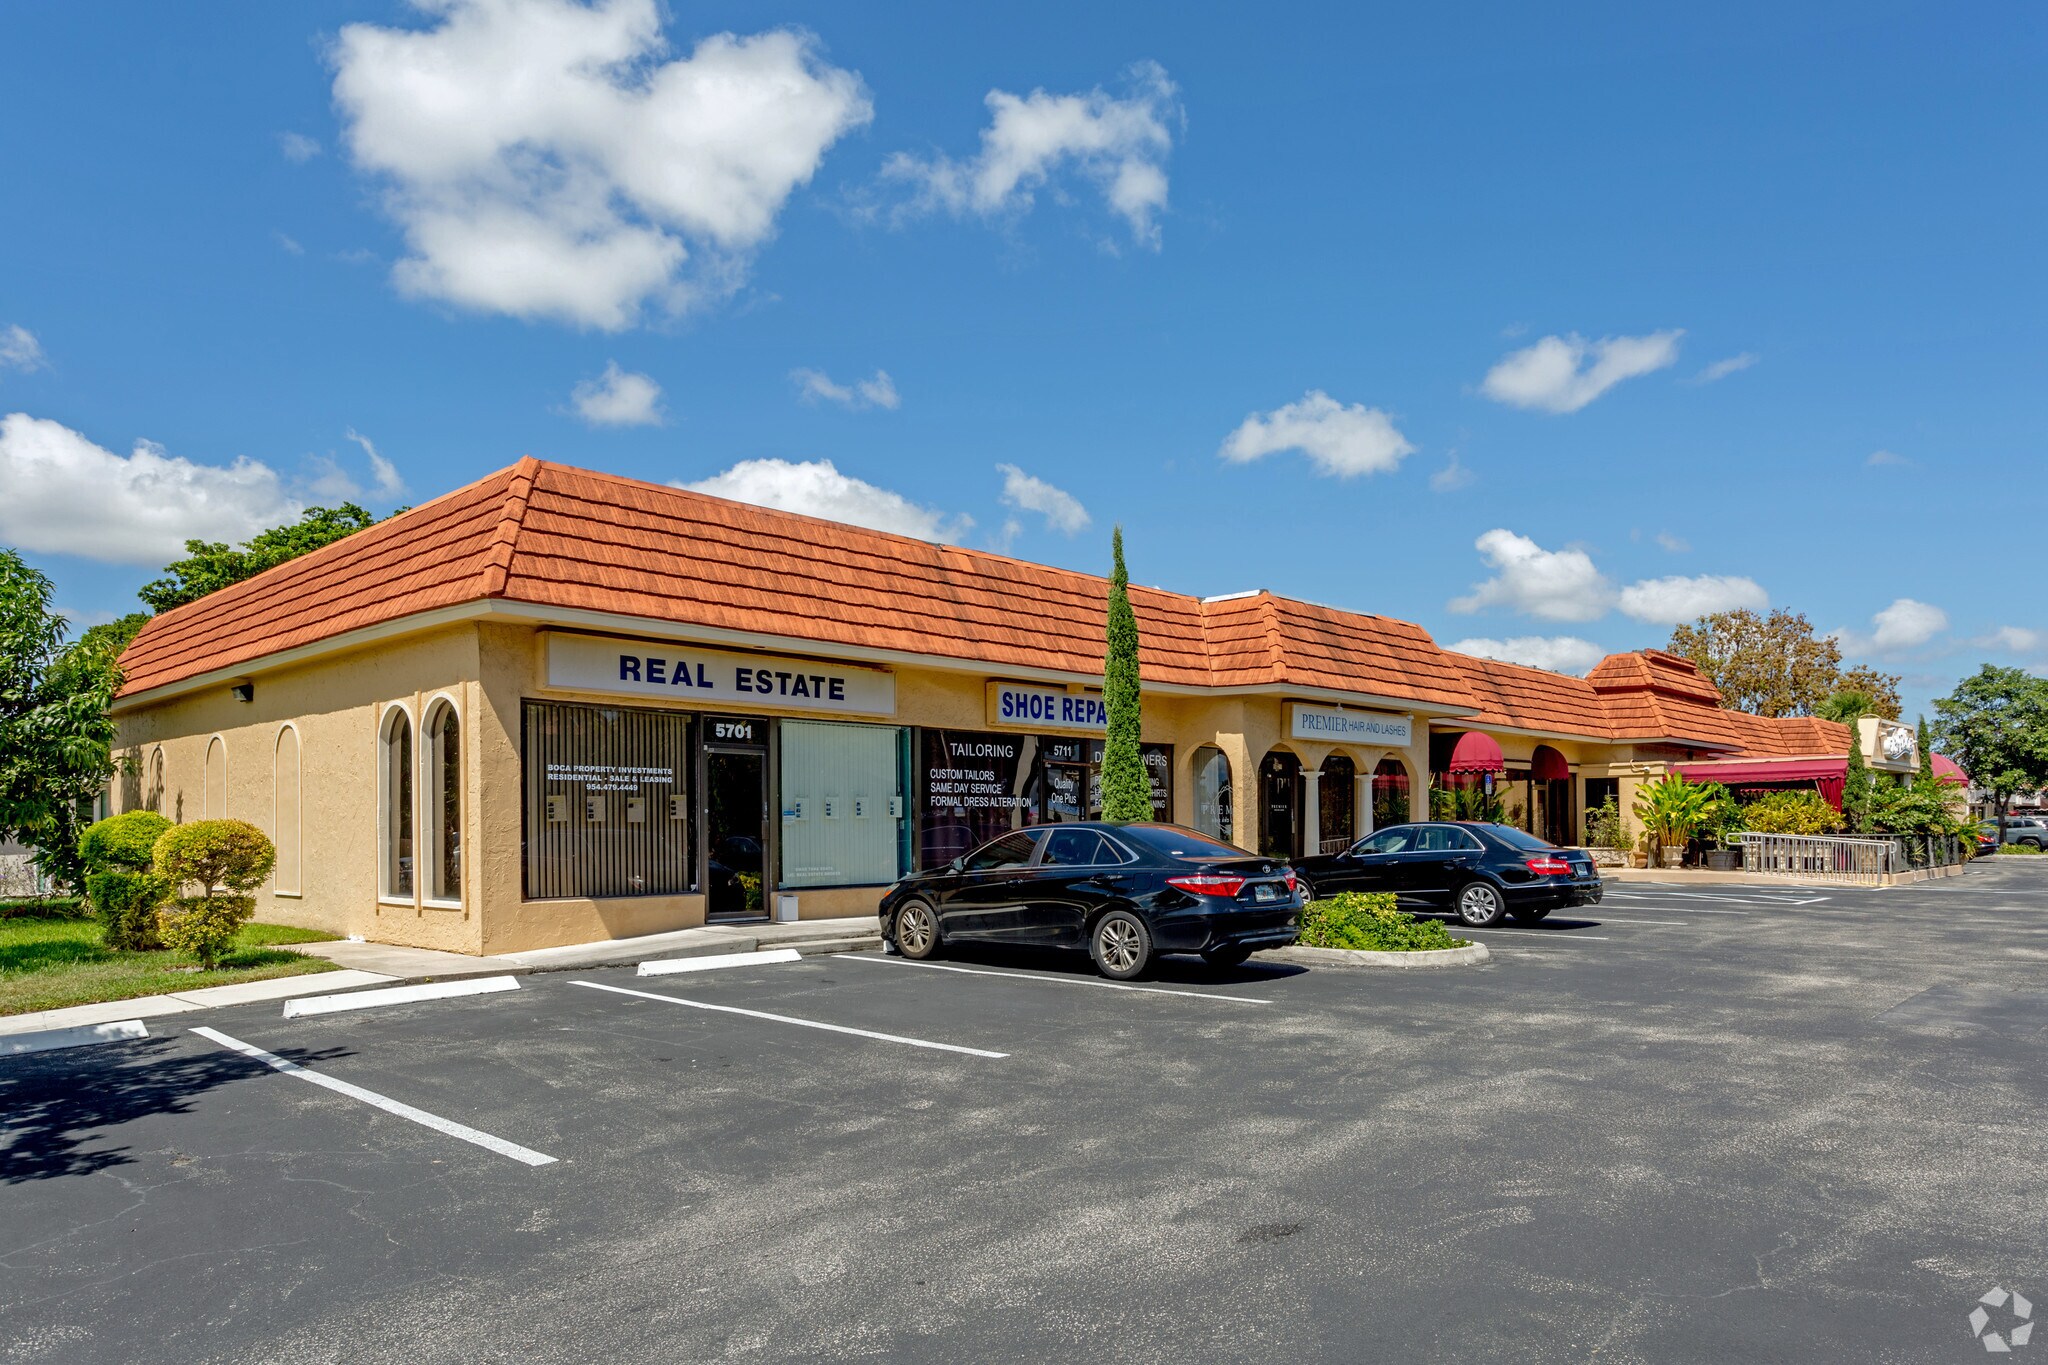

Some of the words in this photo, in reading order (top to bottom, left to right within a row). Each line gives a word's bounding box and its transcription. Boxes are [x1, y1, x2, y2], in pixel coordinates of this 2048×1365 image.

[620, 655, 713, 688] REAL
[736, 667, 844, 700] ESTATE
[1002, 691, 1055, 720] SHOE
[1062, 697, 1107, 724] REPA
[715, 723, 751, 739] 5701
[1302, 713, 1348, 732] PREMIER
[1349, 720, 1365, 732] HAIR
[1366, 722, 1380, 733] AND
[1382, 724, 1406, 737] LASHES
[950, 743, 1014, 758] TAILORING
[1054, 745, 1072, 757] 5711
[547, 764, 571, 772] BOCA
[573, 765, 616, 773] PROPERTY
[618, 766, 673, 775] INVESTMENTS
[930, 768, 963, 779] CUSTOM
[964, 769, 995, 781] TAILORS
[547, 773, 602, 781] RESIDENTIAL
[640, 776, 673, 784] LEASING
[586, 783, 638, 791] 954.479.4449
[930, 782, 953, 793] SAME
[954, 782, 969, 793] DAY
[970, 783, 1002, 794] SERVICE
[1054, 778, 1074, 792] Quality
[1051, 792, 1063, 804] One
[1064, 793, 1077, 804] Plus
[1151, 788, 1167, 798] HIRTS
[930, 796, 962, 807] FORMAL
[964, 796, 989, 807] DRESS
[989, 797, 1032, 808] ALTERATION
